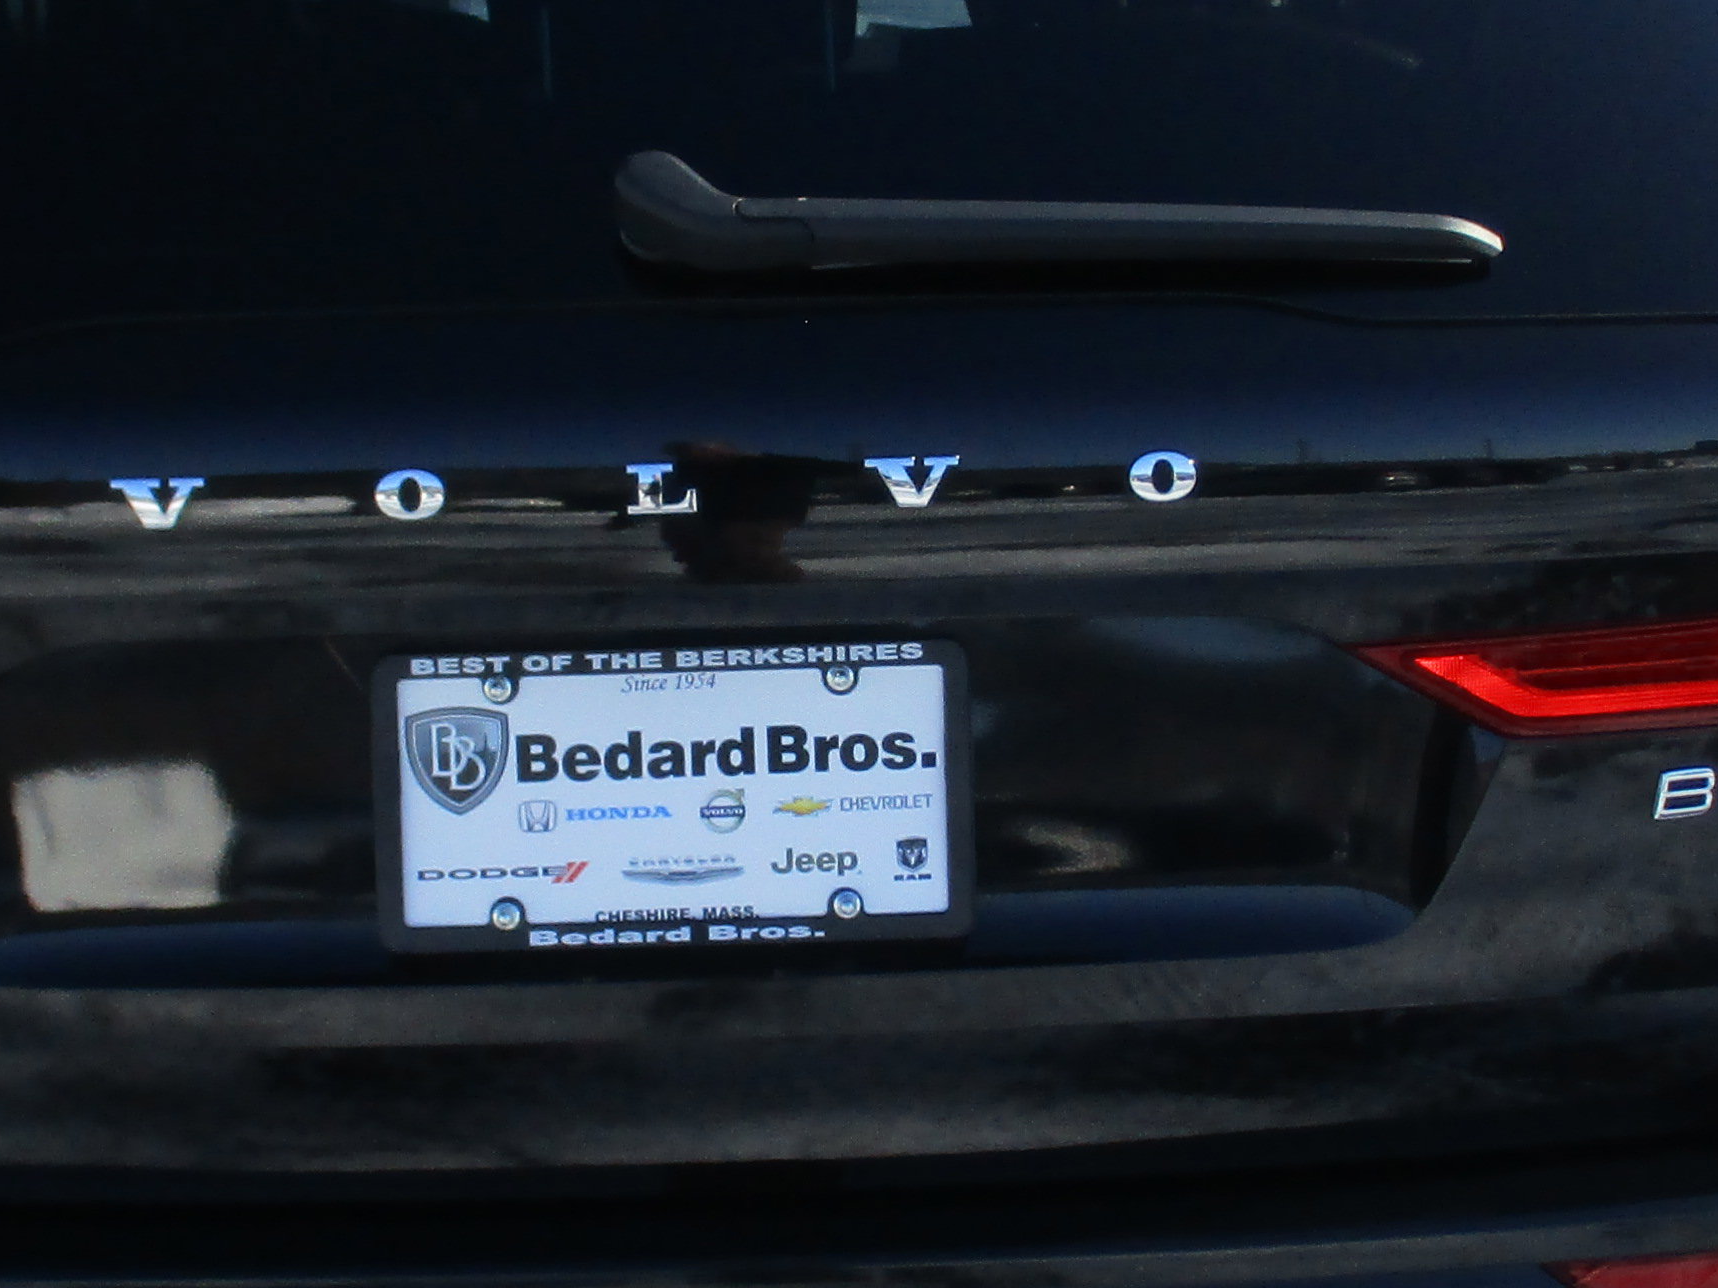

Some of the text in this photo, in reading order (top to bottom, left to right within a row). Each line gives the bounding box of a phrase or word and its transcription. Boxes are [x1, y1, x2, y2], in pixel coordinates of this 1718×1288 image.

[110, 448, 1197, 529] VOLVO
[410, 642, 924, 676] BEST OF THE BERKSHIRES
[620, 671, 716, 694] Since 1954
[565, 805, 673, 822] HONDA
[839, 793, 933, 812] CHEVROLET
[417, 865, 569, 881] DODGE
[770, 848, 860, 876] Jeep
[529, 924, 826, 947] Bedard Bros.
